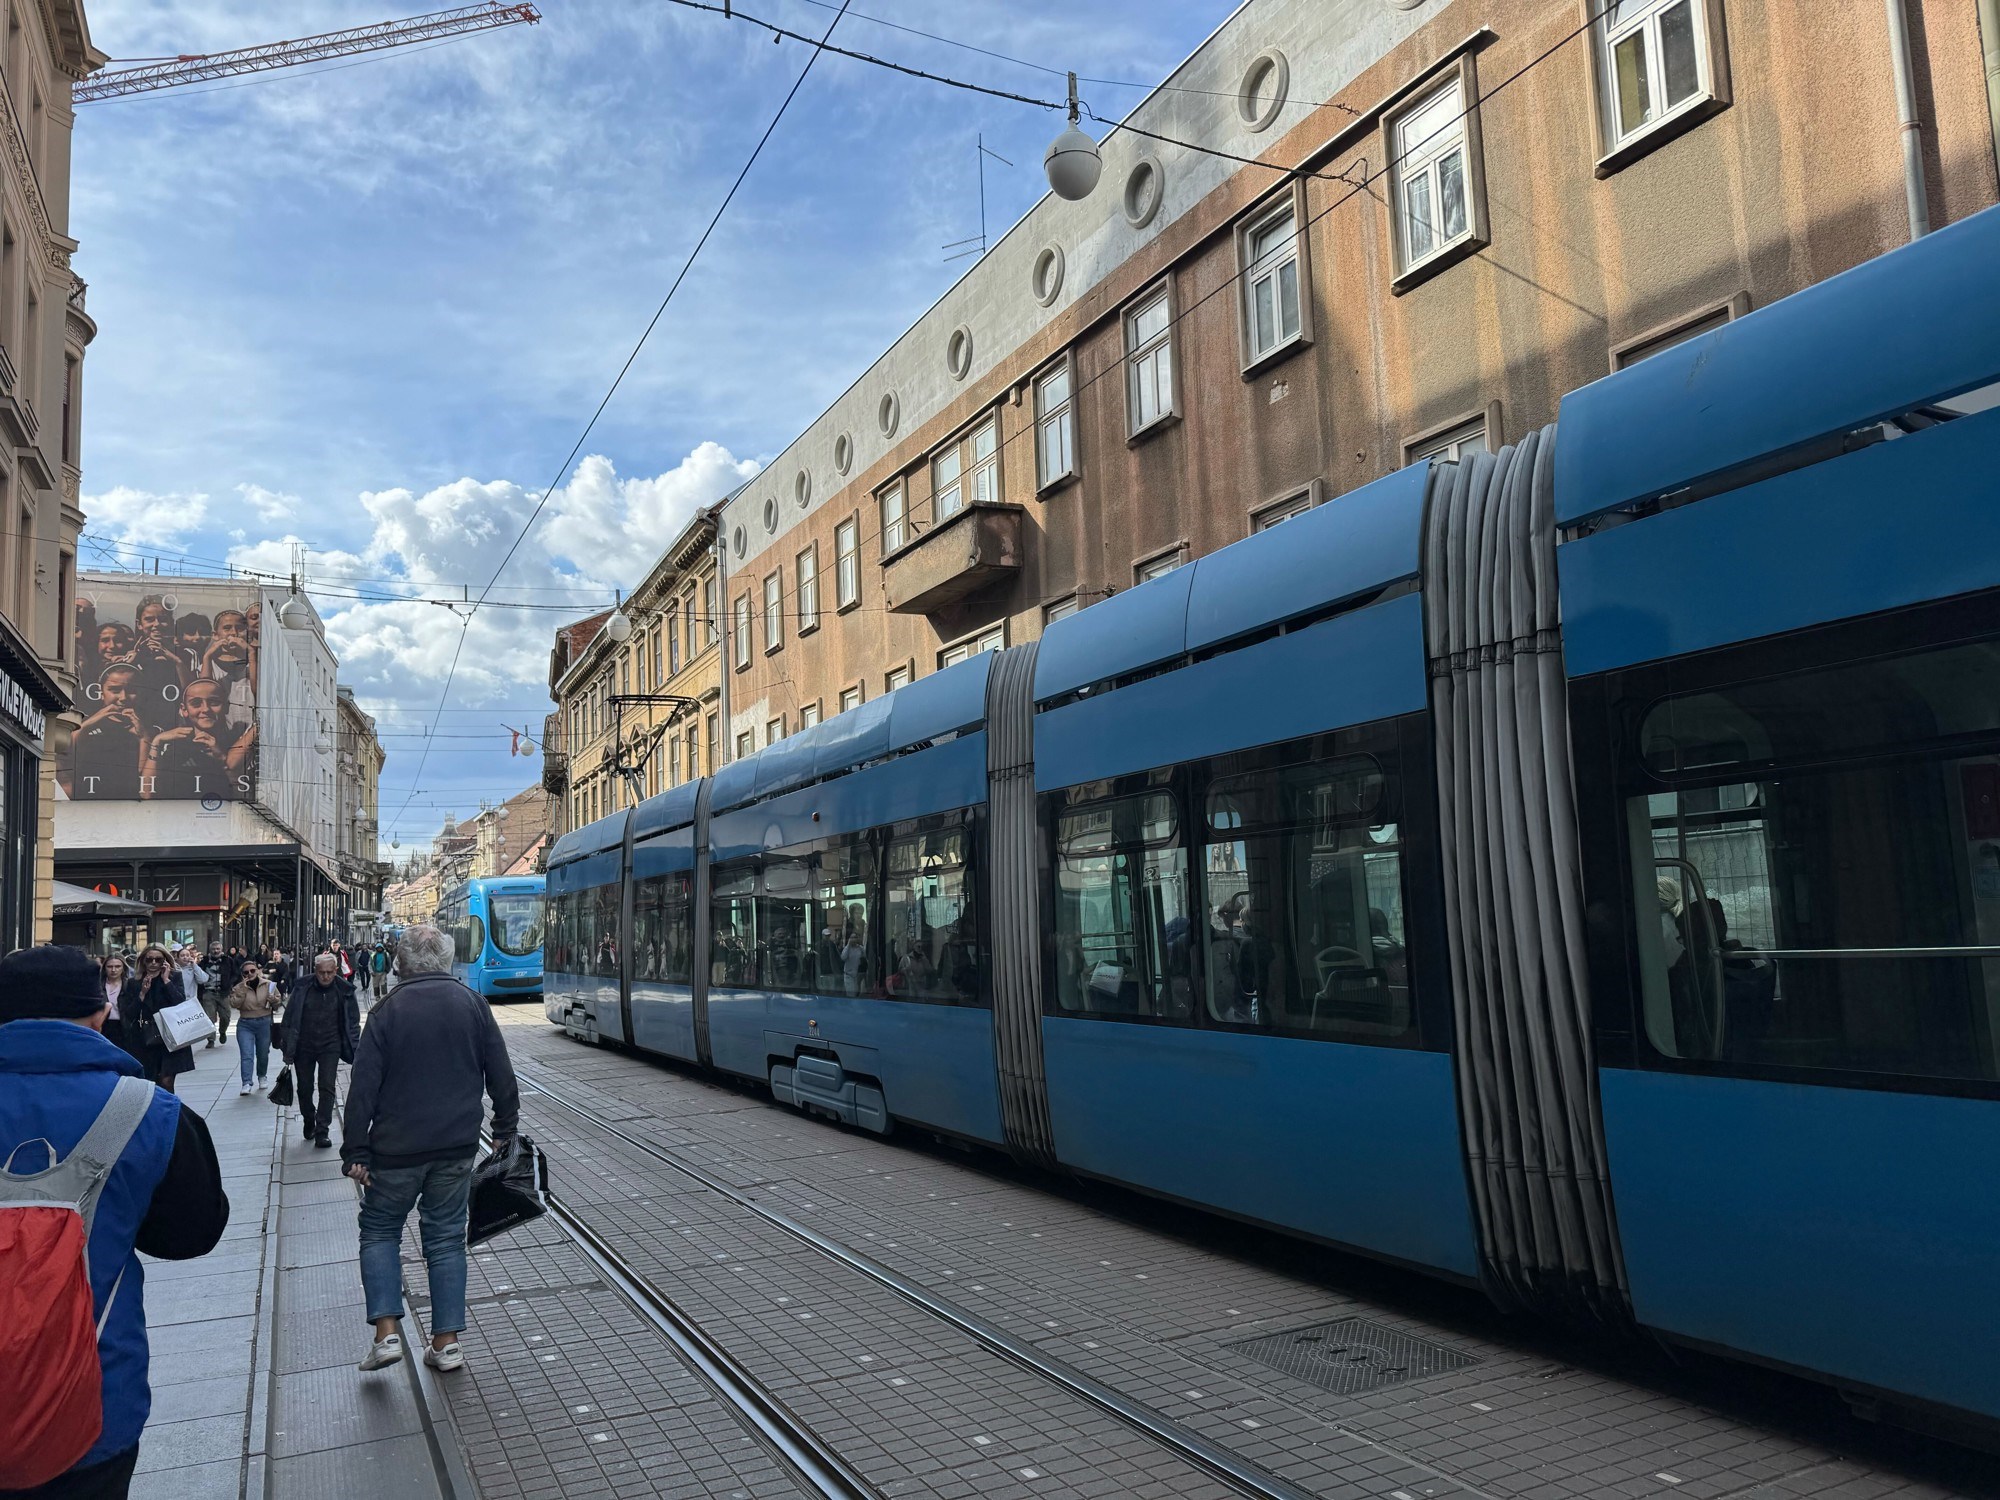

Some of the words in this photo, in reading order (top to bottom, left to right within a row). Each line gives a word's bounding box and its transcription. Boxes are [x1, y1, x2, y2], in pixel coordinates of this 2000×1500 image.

[88, 591, 251, 613] YOU
[86, 683, 253, 702] GOT
[83, 774, 251, 795] THIS
[176, 1012, 205, 1026] MANGO
